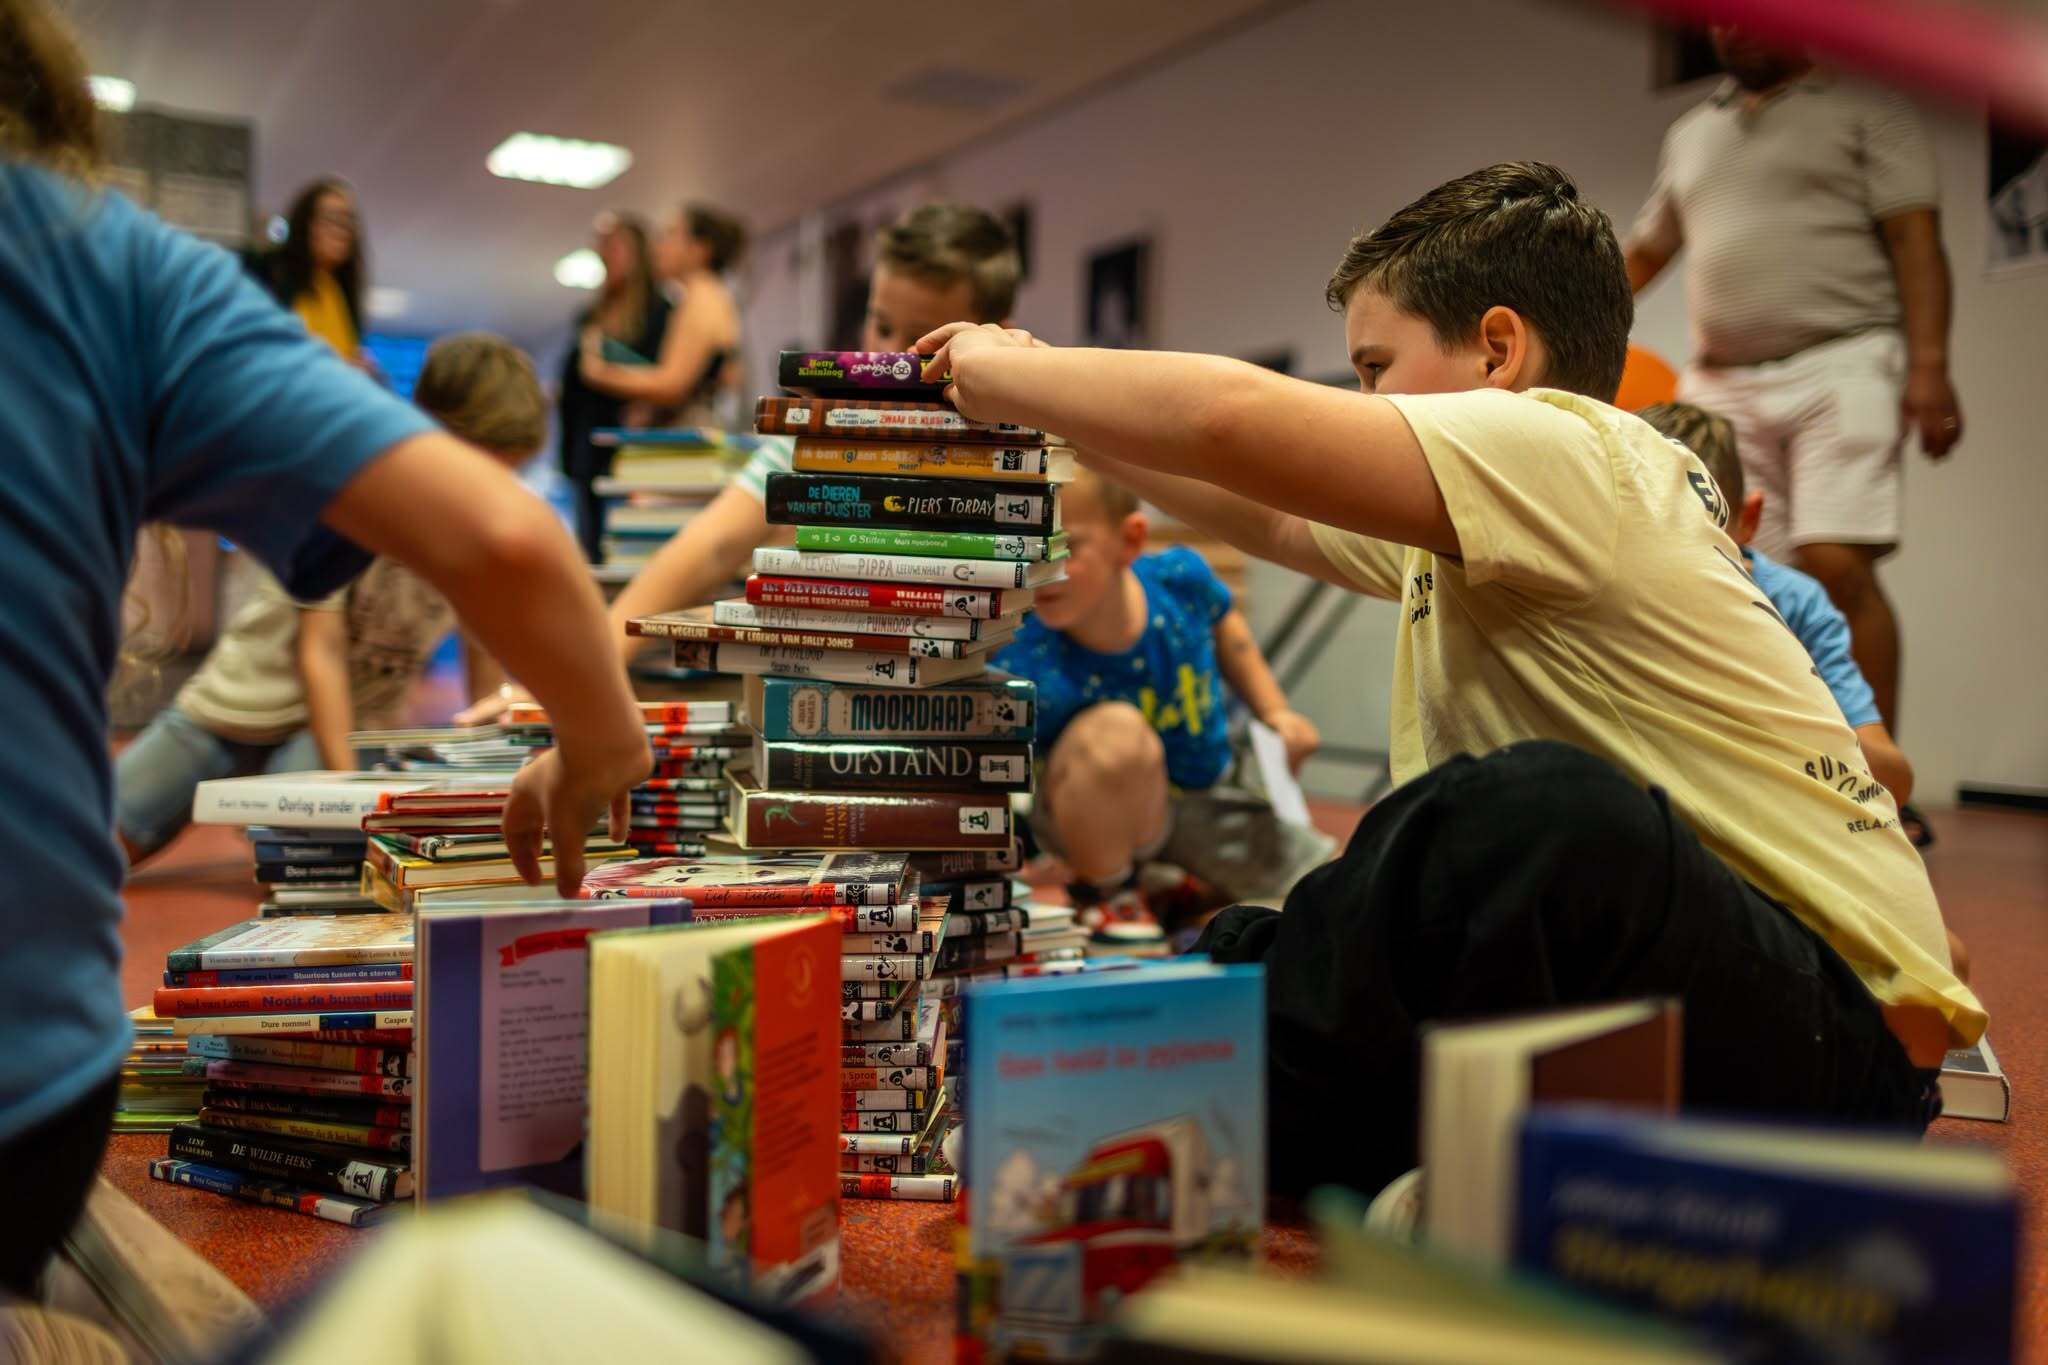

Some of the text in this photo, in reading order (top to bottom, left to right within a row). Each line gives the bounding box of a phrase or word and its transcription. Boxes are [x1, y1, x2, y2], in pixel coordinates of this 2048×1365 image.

[808, 485, 860, 500] DE DIEREN
[825, 501, 871, 518] DUISTER
[907, 496, 996, 516] PIERS TORDAY
[858, 558, 894, 577] PIPPA
[866, 616, 911, 633] PUINHOOP
[747, 632, 780, 644] LEGENDE
[782, 633, 801, 645] VAN
[802, 635, 825, 646] SALLY
[827, 637, 854, 648] JONES
[851, 694, 973, 732] MOORDAAP
[829, 746, 973, 776] OPSTAND
[261, 1020, 279, 1029] Dure
[231, 1143, 315, 1169] DE WILDE HEKS
